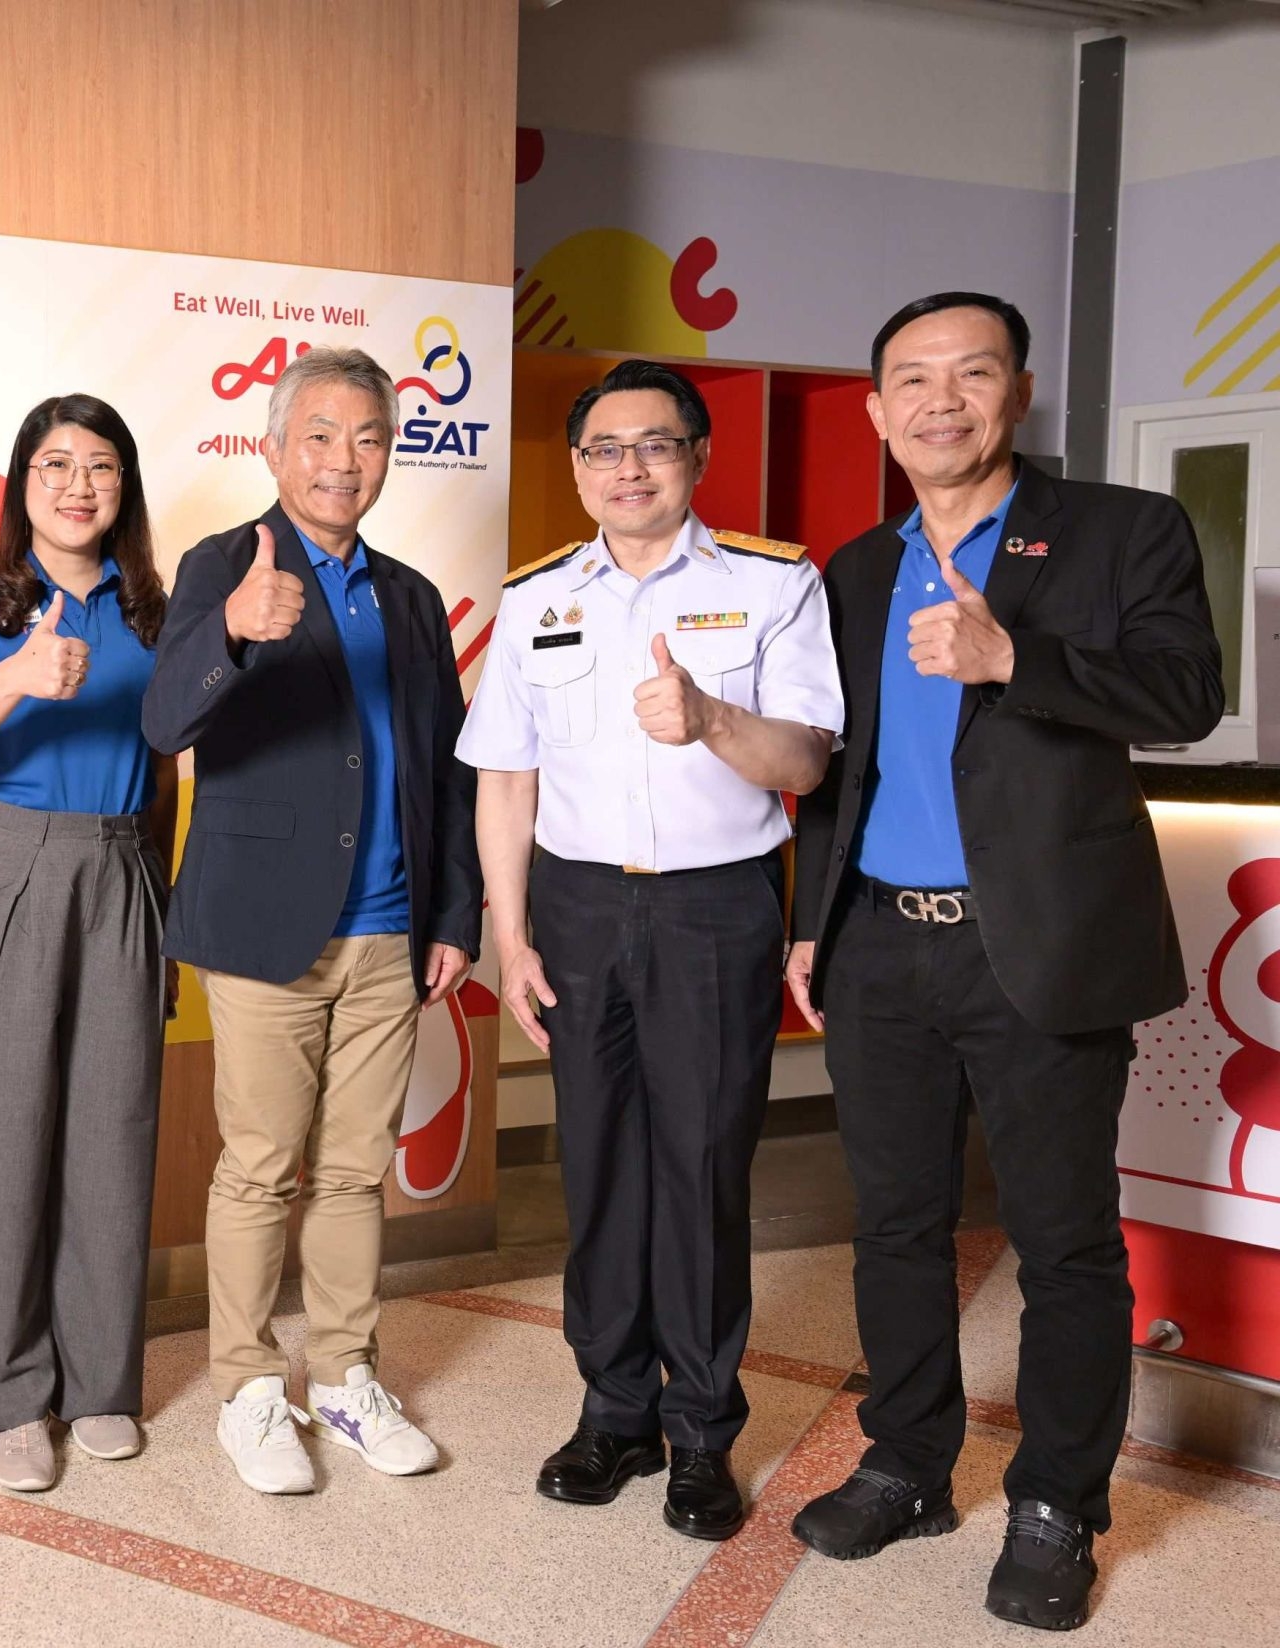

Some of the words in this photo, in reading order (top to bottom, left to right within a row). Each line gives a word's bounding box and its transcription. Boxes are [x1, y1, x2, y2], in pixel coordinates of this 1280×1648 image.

[173, 292, 207, 313] Eat
[214, 296, 266, 320] Well,
[273, 301, 315, 322] Live
[322, 305, 370, 327] Well.
[395, 419, 490, 456] SAT
[394, 458, 417, 468] Sports
[418, 460, 449, 470] Authority
[459, 462, 487, 471] Thailand
